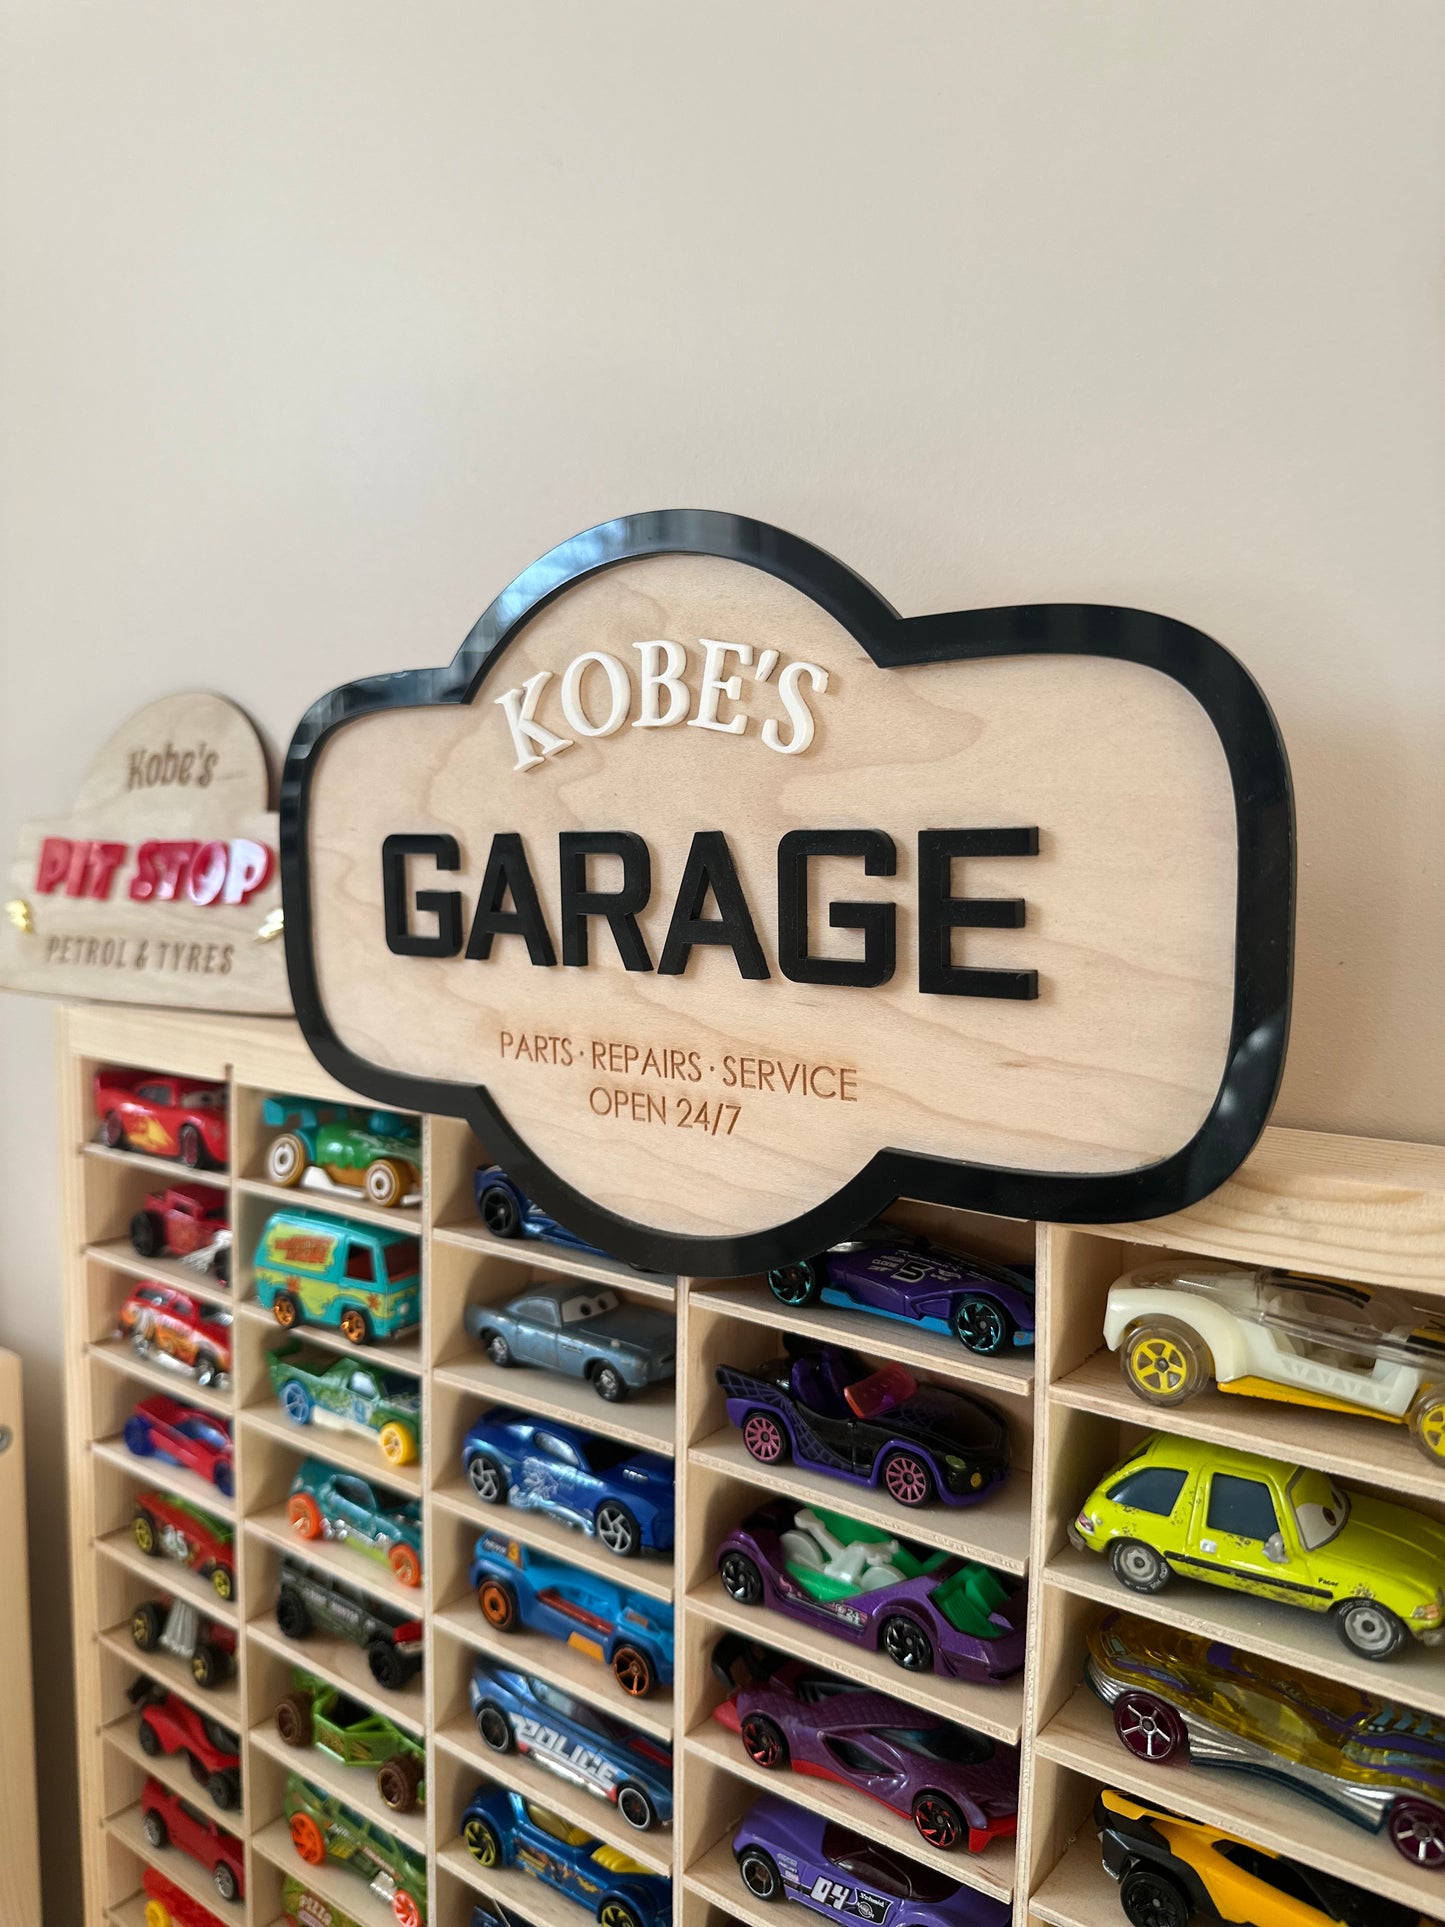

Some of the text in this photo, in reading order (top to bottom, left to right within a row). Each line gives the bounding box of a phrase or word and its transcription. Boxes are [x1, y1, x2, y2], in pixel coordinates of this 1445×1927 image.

[494, 638, 830, 772] KOBE'S
[127, 742, 219, 790] Kobe's
[36, 837, 276, 906] PIT STOP
[381, 826, 1040, 1001] GARAGE
[46, 936, 236, 975] PETROL & TYRES
[722, 1055, 859, 1103] SERVICE
[589, 1086, 743, 1137] OPEN 24/7
[512, 1713, 617, 1791] POLICE
